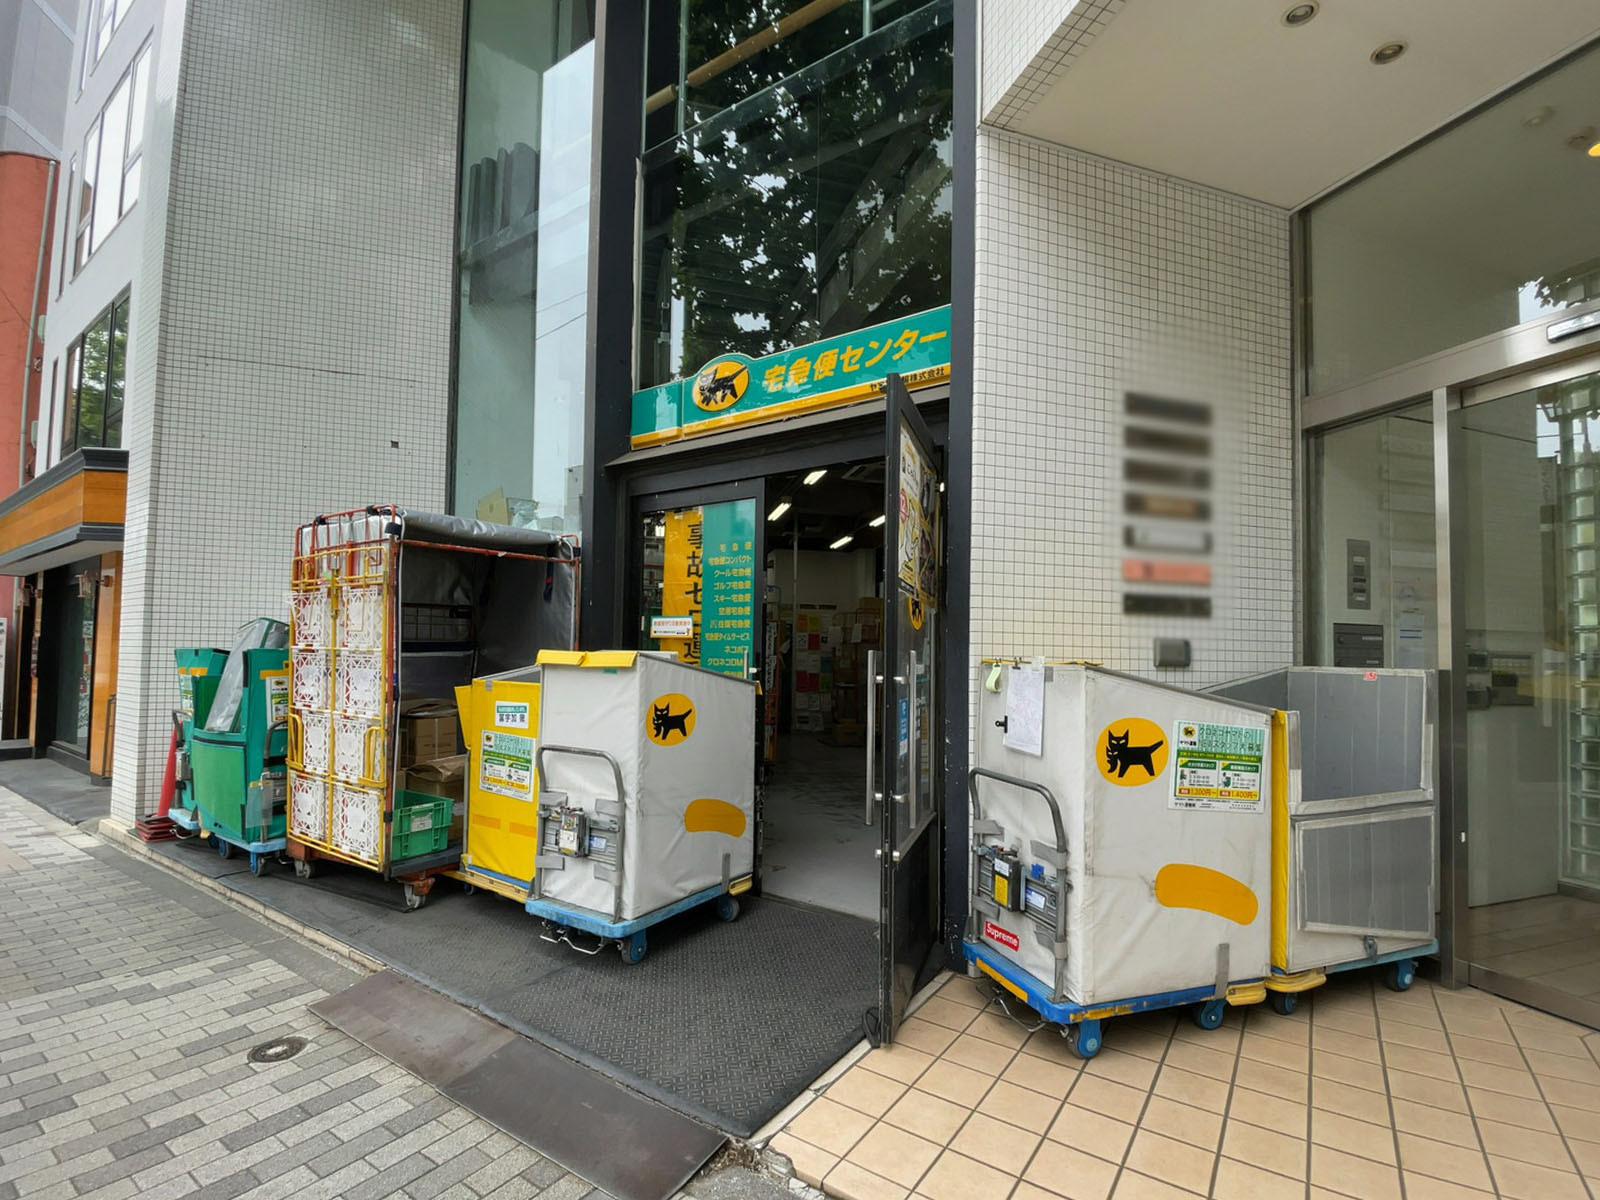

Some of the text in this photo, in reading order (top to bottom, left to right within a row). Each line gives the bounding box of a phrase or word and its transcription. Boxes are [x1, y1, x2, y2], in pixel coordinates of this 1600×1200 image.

[763, 329, 947, 393] 宅急便センター
[985, 922, 1019, 946] Supreme
